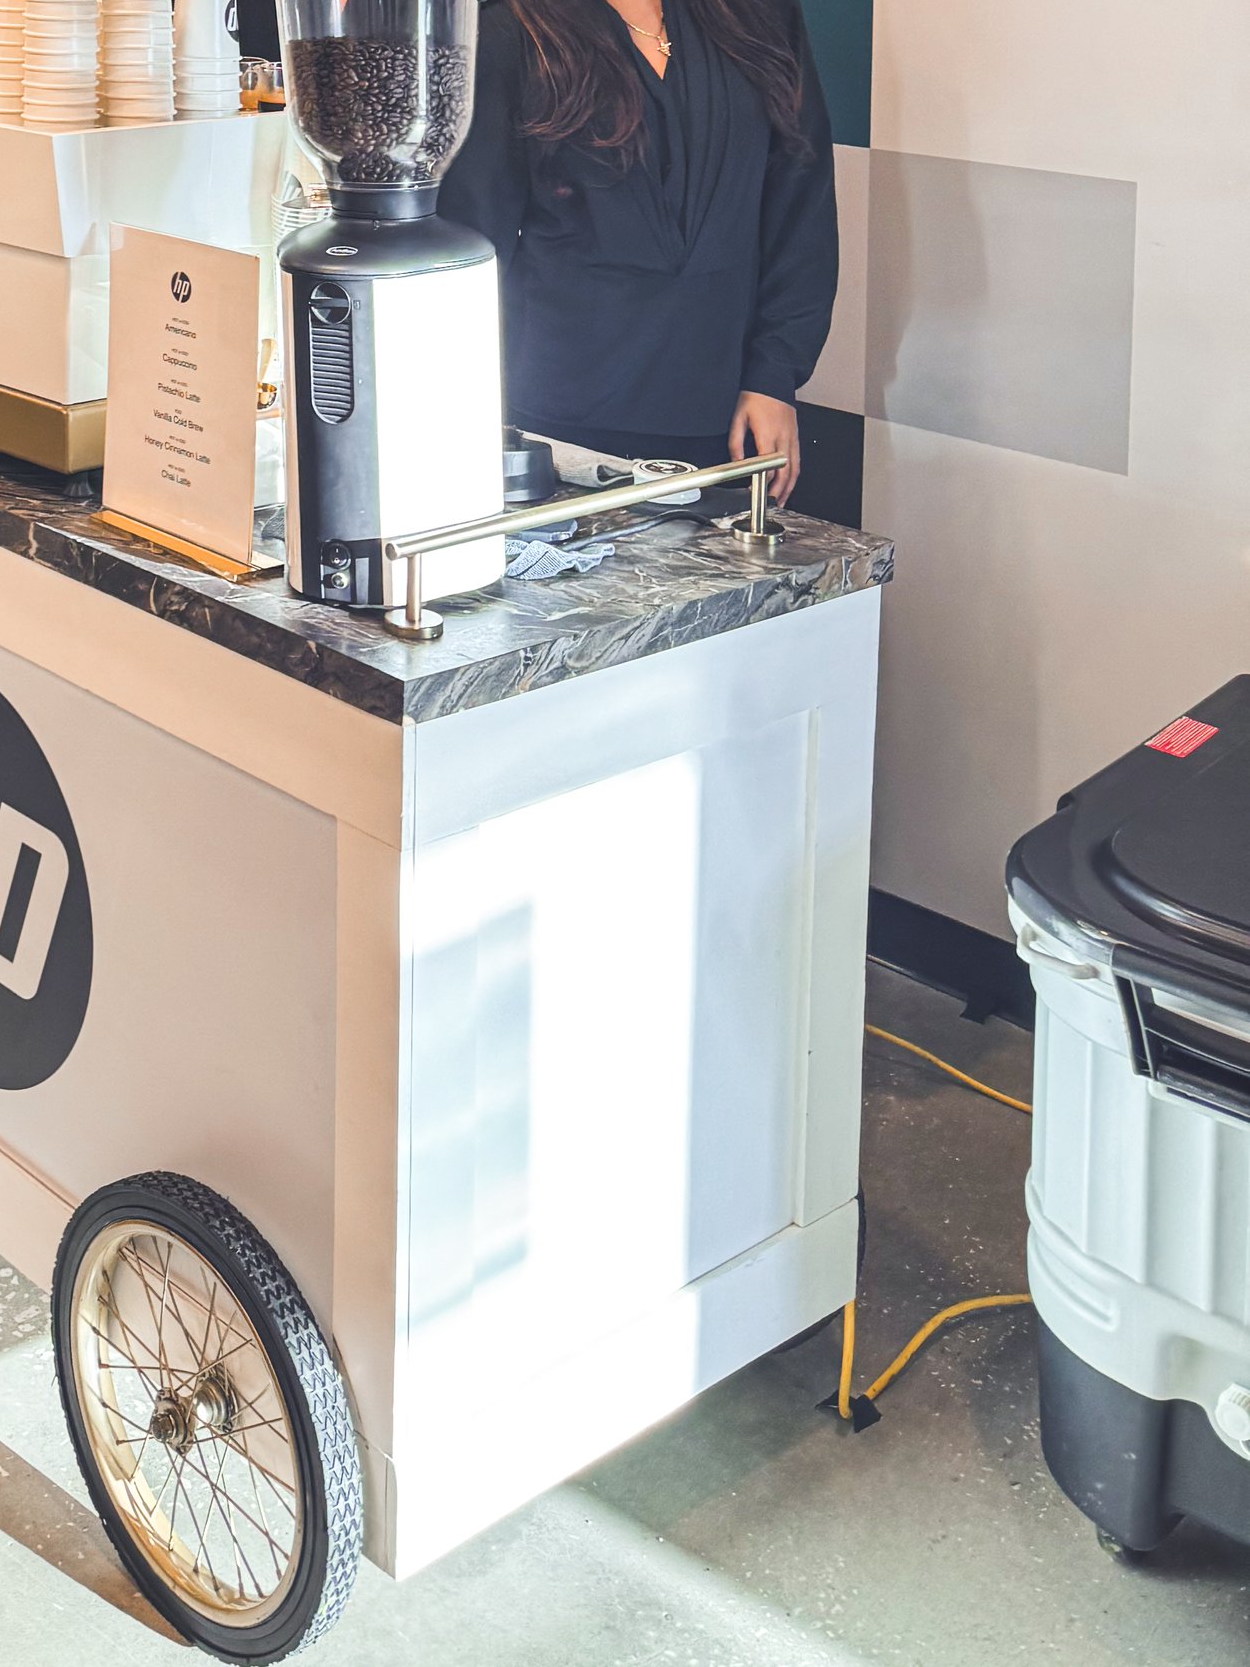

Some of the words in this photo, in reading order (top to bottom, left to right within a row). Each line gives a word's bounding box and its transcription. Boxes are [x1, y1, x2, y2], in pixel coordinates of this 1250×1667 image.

[172, 271, 191, 303] hp
[153, 409, 172, 422] Vanilla
[173, 415, 187, 427] Cold
[188, 420, 204, 432] Brew
[144, 434, 163, 449] Honey
[164, 441, 194, 458] Cinnamon
[161, 469, 175, 481] Chai
